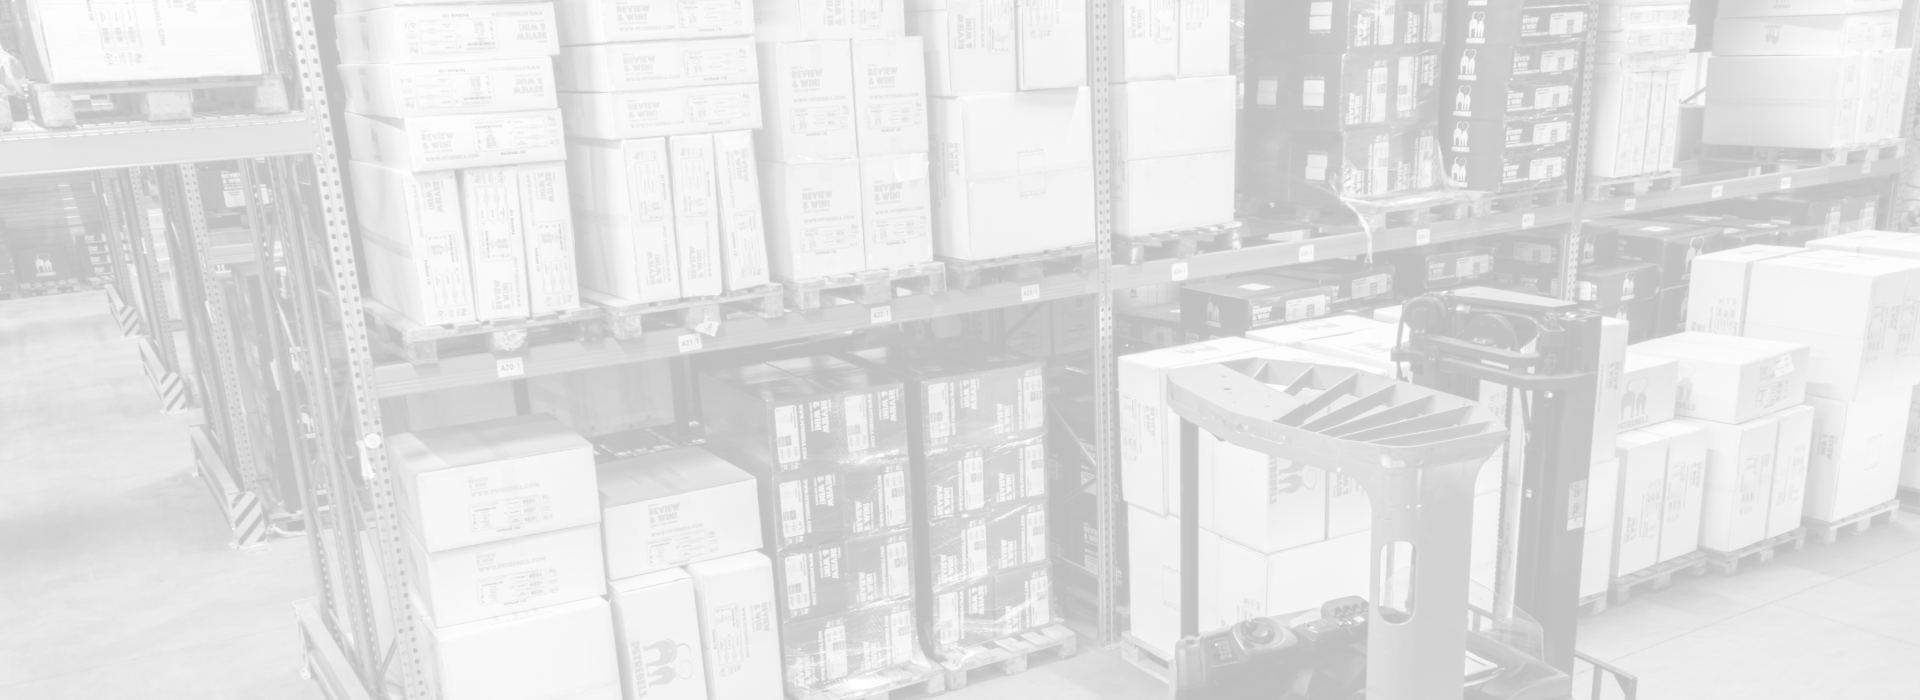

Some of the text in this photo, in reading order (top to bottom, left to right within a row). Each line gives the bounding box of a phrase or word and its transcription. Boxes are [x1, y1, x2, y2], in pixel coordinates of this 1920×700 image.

[616, 4, 650, 14] REVIEW
[626, 13, 647, 21] WIN!
[518, 22, 546, 31] & WIN!
[957, 14, 965, 50] REVIEW
[964, 18, 972, 49] & WIN!
[517, 32, 548, 41] REVIEW
[622, 55, 656, 64] REVIEW
[632, 64, 654, 72] WIN!
[791, 69, 823, 79] REVIEW
[868, 66, 898, 76] REVIEW
[792, 79, 820, 88] & WIN!
[868, 76, 896, 86] & WIN!
[514, 86, 544, 94] REVIEW
[628, 102, 660, 111] REVIEW
[637, 110, 658, 118] WIN!
[421, 132, 454, 142] REVIEW
[431, 140, 452, 148] WIN!
[740, 149, 750, 182] REVIEW
[545, 172, 555, 203] REVIEW
[874, 182, 904, 192] REVIEW
[426, 190, 435, 212] WIN!
[432, 180, 444, 214] REVIEW
[802, 190, 833, 200] REVIEW
[874, 192, 901, 202] & WIN!
[802, 200, 830, 210] & WIN!
[647, 251, 656, 286] REVIEW
[654, 254, 662, 277] WIN!
[689, 246, 697, 281] REVIEW
[698, 270, 704, 279] &
[493, 280, 502, 310] REVIEW
[1024, 288, 1038, 297] A23-1
[504, 302, 511, 310] &
[874, 310, 889, 320] A22-1
[681, 338, 700, 348] A21-1
[500, 362, 520, 372] A20-1
[970, 378, 978, 410] REVIEW
[882, 398, 890, 420] WIN!
[888, 389, 897, 421] REVIEW
[814, 410, 822, 432] WIN!
[820, 400, 830, 433] REVIEW
[1826, 434, 1836, 460] REVIEW
[1269, 456, 1278, 505] ETREBELS
[470, 482, 540, 497] WWW.PETREBELS.COM
[819, 484, 827, 505] WIN!
[824, 474, 834, 507] REVIEW
[648, 502, 680, 516] REVIEW
[656, 512, 678, 522] WIN!
[855, 501, 864, 533] REVIEW
[650, 523, 704, 537] WWW.PETREBELS.COM
[1000, 540, 1008, 569] REVIEW
[478, 556, 547, 573] WWW.PETREBELS.COM
[830, 547, 839, 580] REVIEW
[858, 572, 867, 603] REVIEW
[762, 601, 771, 632] REVIEW
[630, 642, 648, 698] PETREBELS
